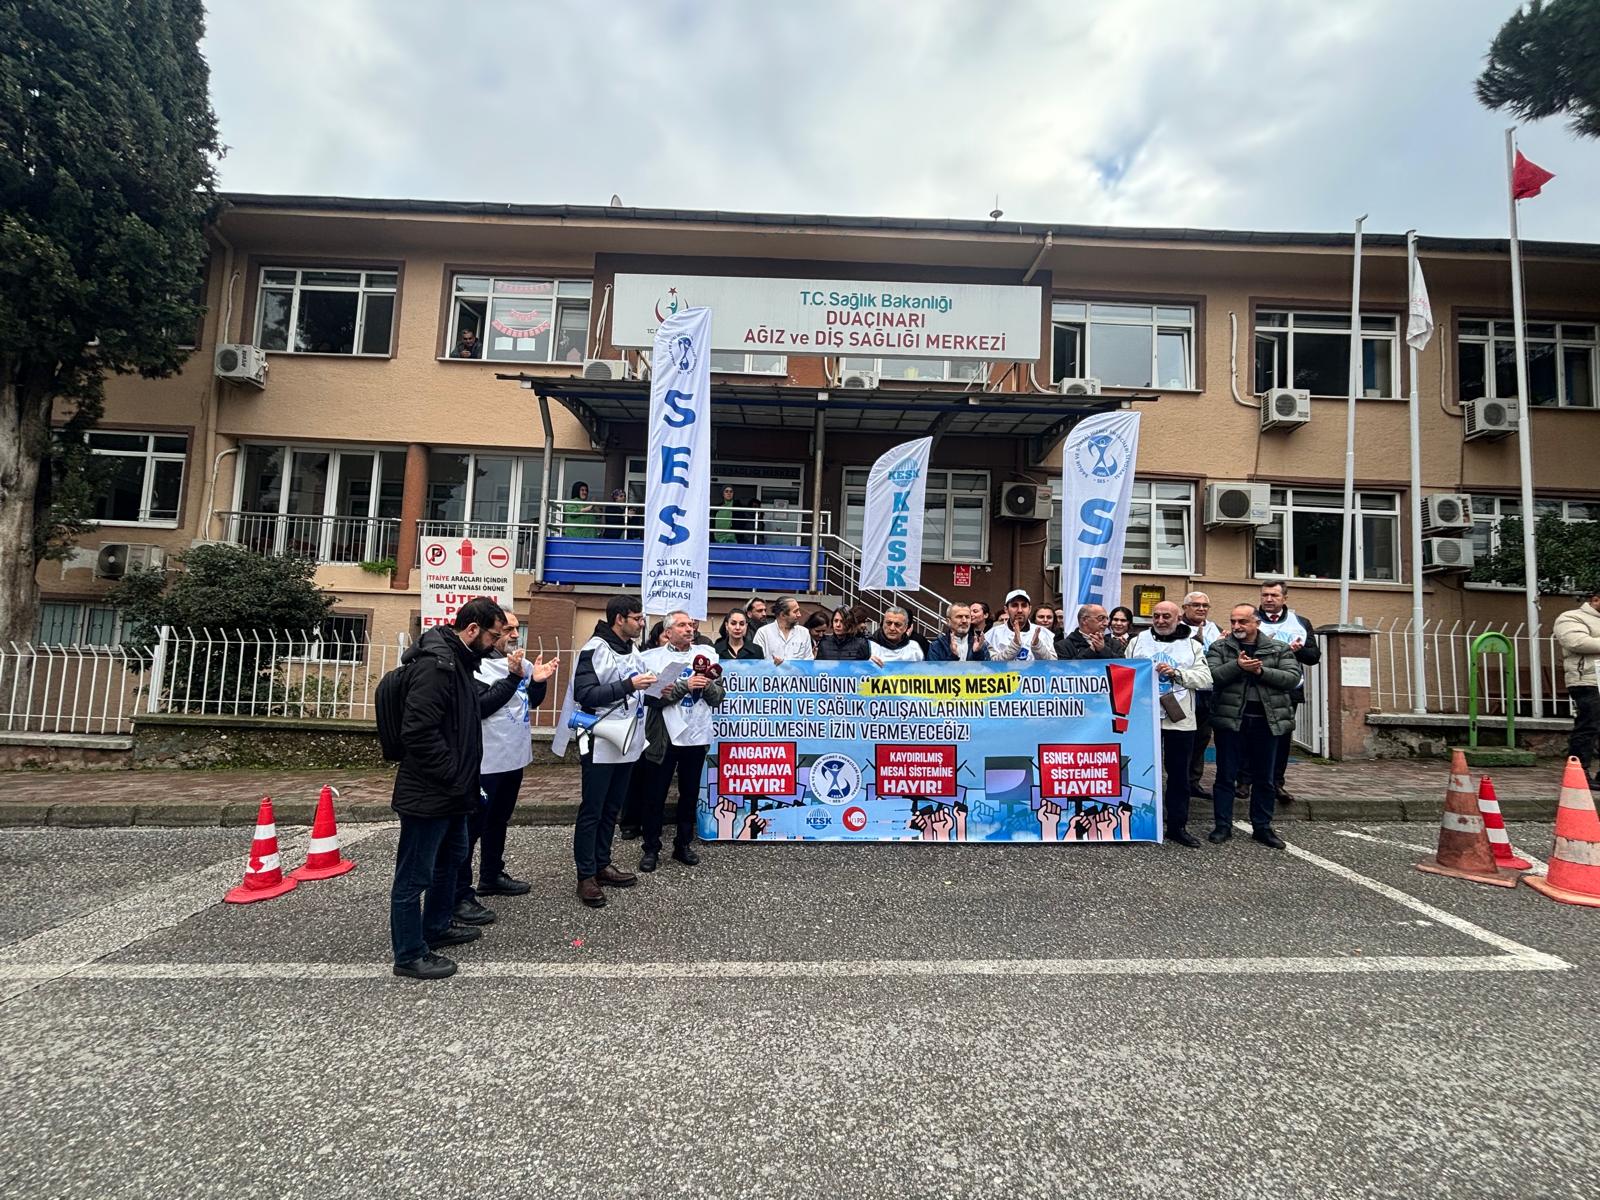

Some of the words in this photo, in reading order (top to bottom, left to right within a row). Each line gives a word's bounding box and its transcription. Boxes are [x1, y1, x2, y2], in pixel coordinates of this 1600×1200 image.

[800, 291, 827, 306] T.C.
[829, 292, 877, 310] Sağlık
[881, 293, 953, 313] Bakanlığı
[826, 310, 925, 328] DUAÇINARI
[744, 325, 785, 344] AĞIZ
[790, 333, 809, 345] ve
[815, 327, 844, 348] DİŞ
[849, 329, 920, 348] SAĞLIĞI
[926, 332, 1006, 351] MERKEZİ
[886, 491, 911, 587] KESK
[670, 568, 701, 579] HİZMET
[429, 582, 456, 590] HİDRANT
[483, 584, 505, 592] ÖNÜNE
[722, 673, 758, 692] AĞLIK
[763, 674, 856, 694] BAKANLIĞININ
[1022, 677, 1045, 693] ADI
[1050, 677, 1110, 693] ALTINDA
[797, 700, 814, 715] VE
[818, 696, 865, 716] SAĞLIK
[870, 701, 984, 720] ÇALIŞANLARININ
[989, 697, 1084, 717] EMEKLERİNİN
[712, 718, 826, 738] SÖMÜRÜLMESİNE
[830, 719, 856, 739] İZİN
[860, 721, 969, 741] VERMEYECEĞİZ!
[729, 746, 787, 759] ANGARYA
[890, 752, 943, 764] KAYDIRILMIŞ
[1043, 752, 1074, 764] ESNEK
[1077, 752, 1117, 766] ÇALIŞMA
[723, 763, 792, 779] ÇALIŞMAYA
[880, 764, 907, 777] MESAİ
[909, 765, 953, 777] SİSTEMİNE
[1051, 766, 1108, 779] SİSTEMİNE
[728, 778, 786, 793] HAYIR!
[883, 780, 942, 793] HAYIR!
[1053, 780, 1112, 795] HAYIR!
